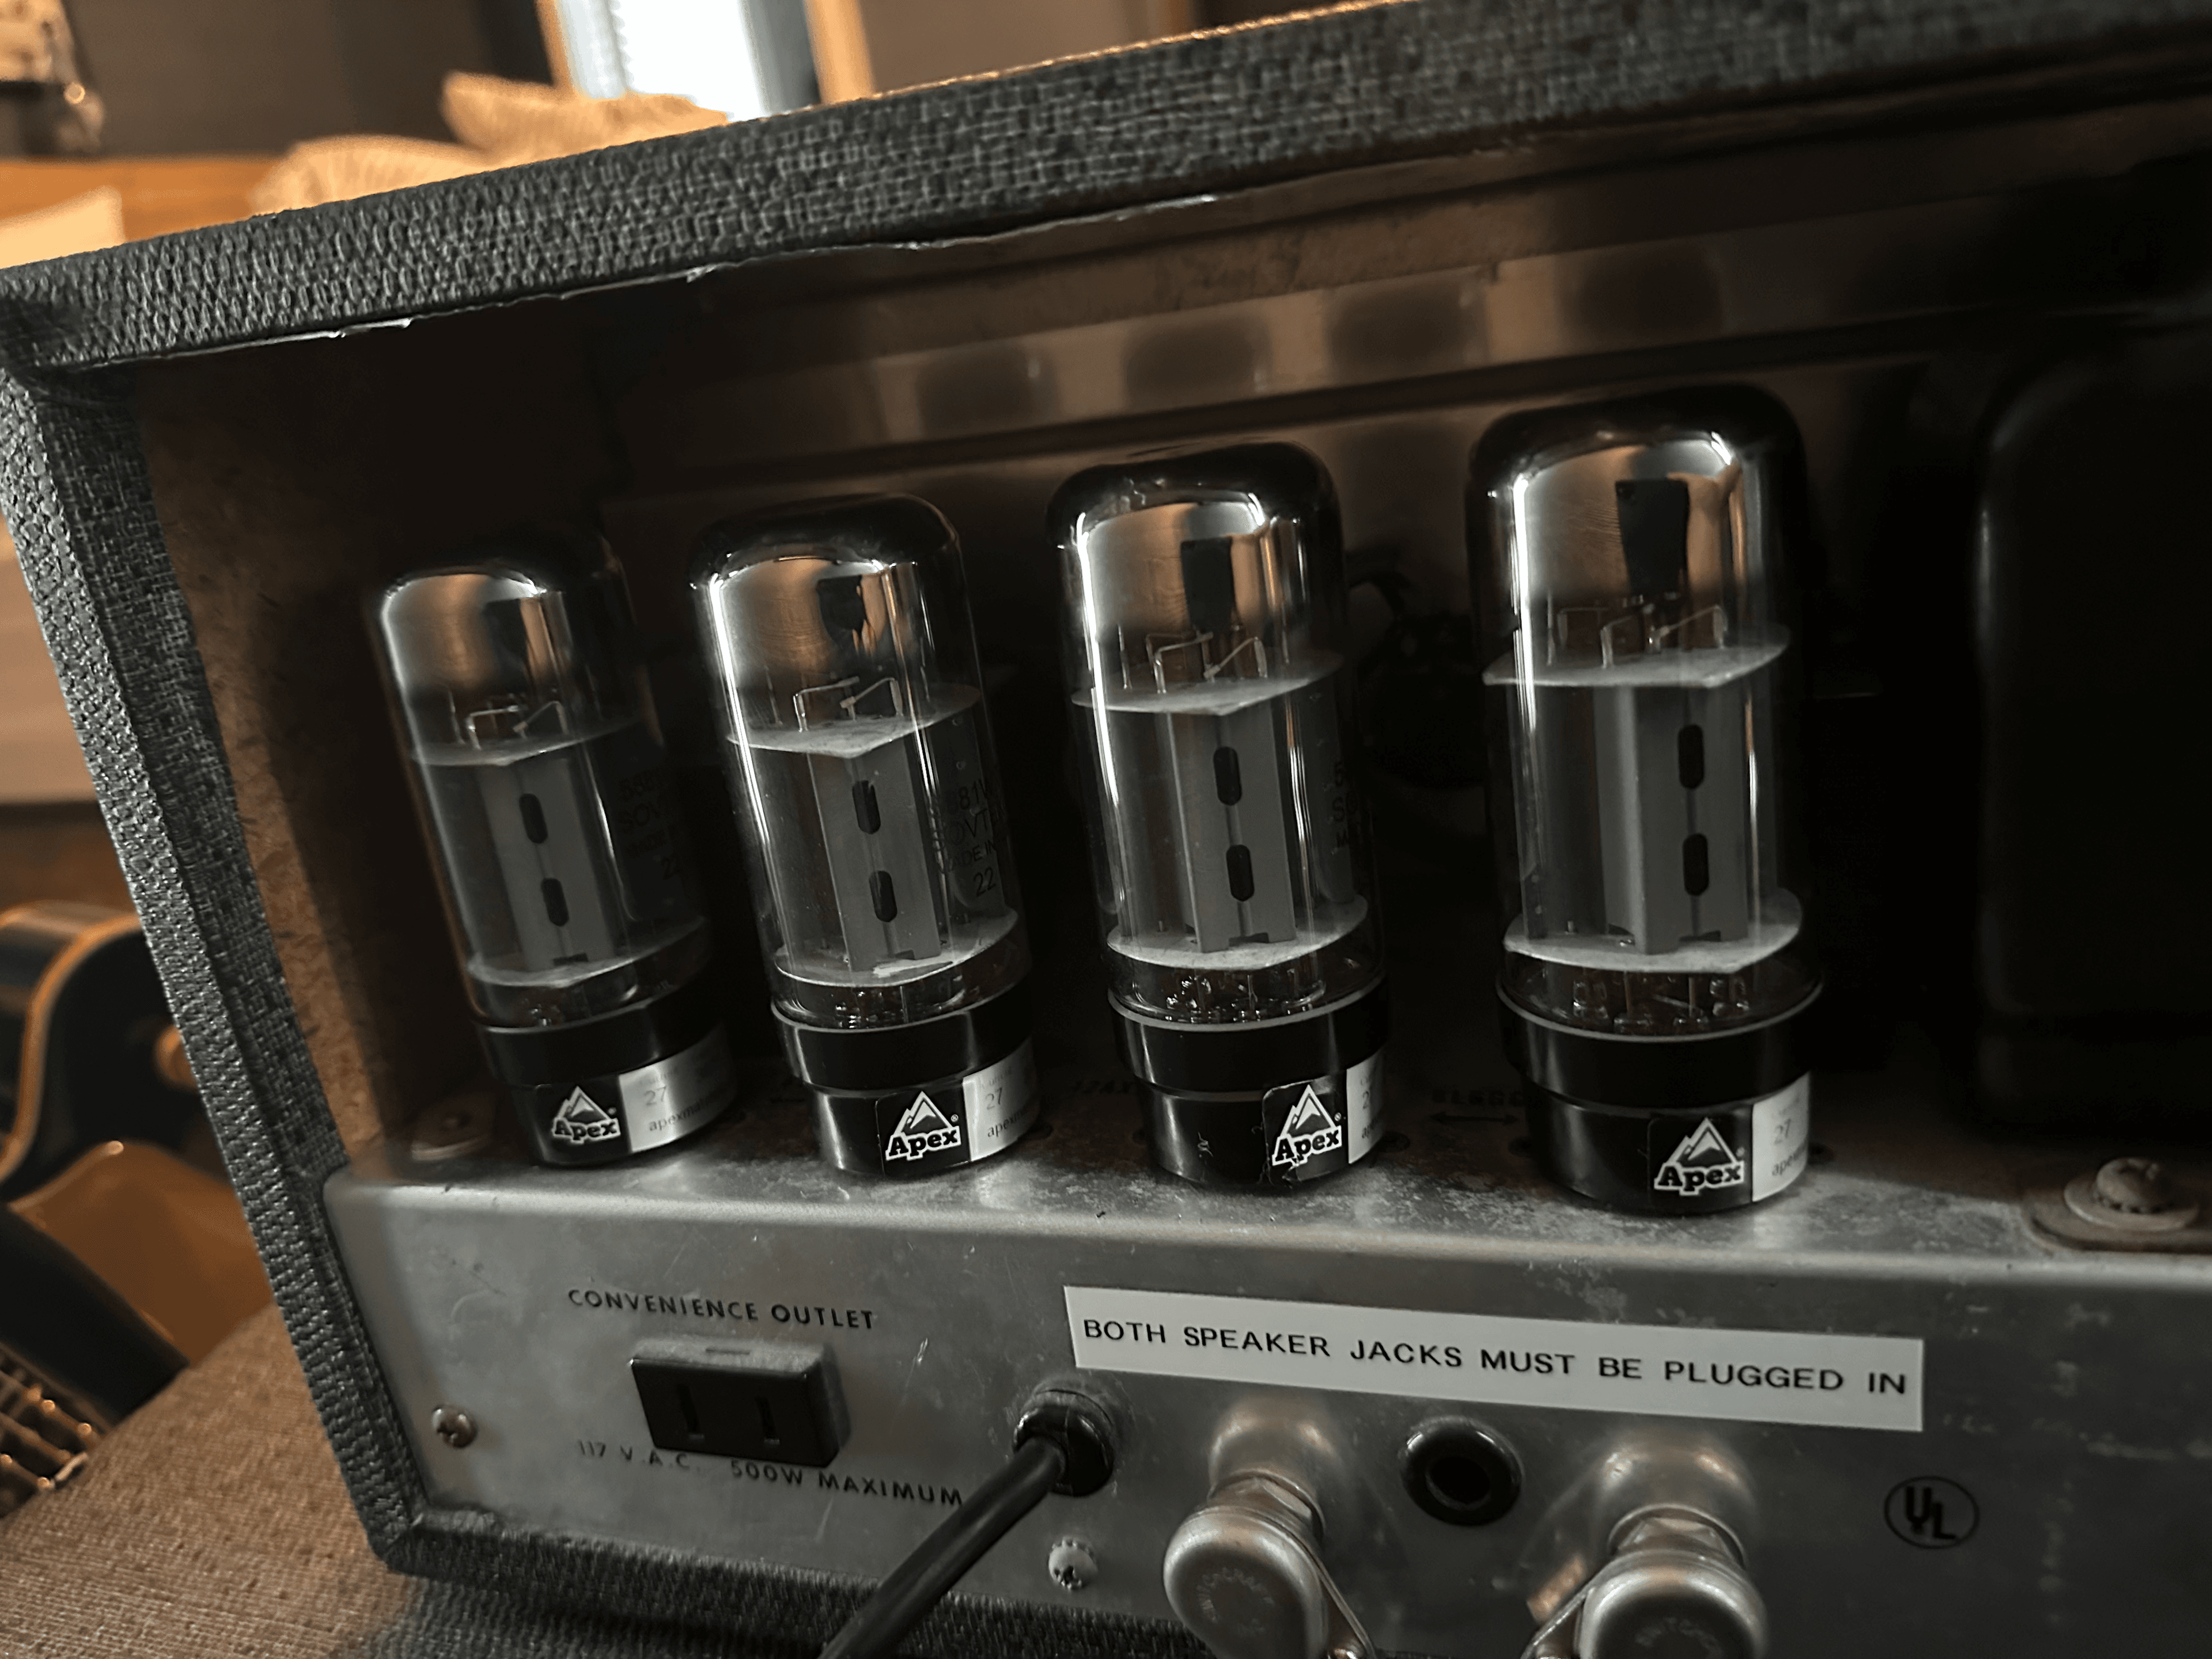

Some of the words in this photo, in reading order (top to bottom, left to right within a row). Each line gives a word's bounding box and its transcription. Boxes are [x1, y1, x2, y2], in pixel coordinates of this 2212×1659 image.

[973, 866, 997, 897] 22
[644, 1086, 666, 1107] 27
[985, 1087, 1002, 1110] 27
[554, 1120, 619, 1141] Apex
[887, 1127, 959, 1158] Apex
[1273, 1127, 1340, 1164] Apex
[1656, 1162, 1743, 1194] Apex
[568, 1289, 759, 1321] CONVENIENCE
[771, 1303, 873, 1330] OUTLET
[1083, 1319, 1166, 1344] BOTH
[1184, 1326, 1330, 1357] SPEAKER
[1350, 1340, 1462, 1368] JACKS
[1480, 1349, 1575, 1375] MUST
[1598, 1357, 1642, 1379] BE
[1665, 1361, 1843, 1391] PLUGGED
[1868, 1372, 1906, 1394] IN
[578, 1440, 606, 1458] 117
[730, 1458, 803, 1486] 500W
[818, 1470, 963, 1506] MAXIMUM
[1906, 1485, 1957, 1540] UL
